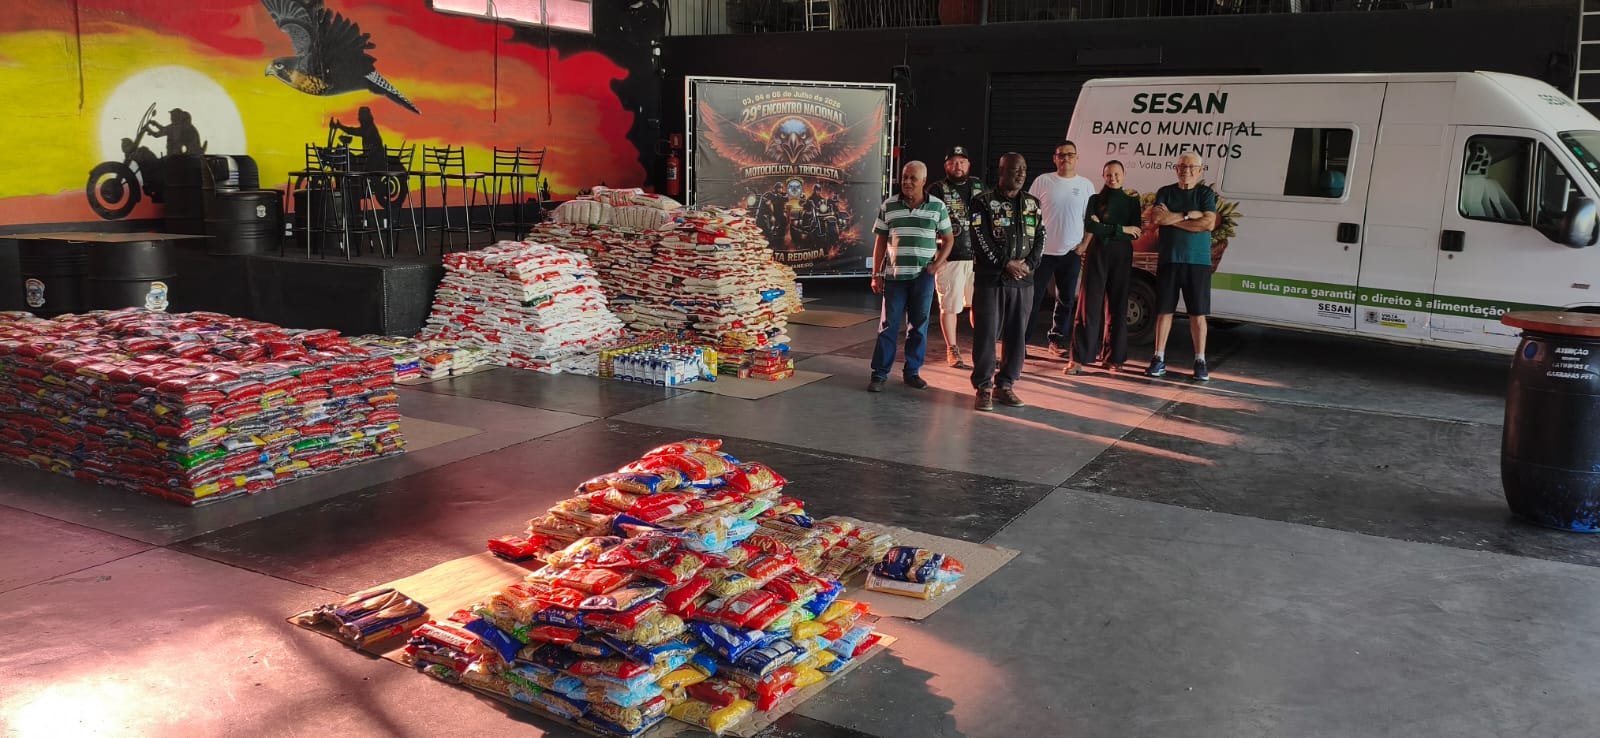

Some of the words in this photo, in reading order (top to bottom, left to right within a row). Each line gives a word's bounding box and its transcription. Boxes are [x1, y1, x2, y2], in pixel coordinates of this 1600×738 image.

[793, 91, 813, 99] Julho
[814, 94, 823, 102] de
[1131, 92, 1228, 114] SESAN
[761, 102, 801, 117] ENCONTRO
[803, 103, 843, 123] NACIONAL
[1092, 121, 1151, 135] BANCO
[1157, 121, 1263, 136] MUNICIPAL
[1106, 142, 1128, 156] DE
[1135, 142, 1242, 159] ALIMENTOS
[744, 165, 794, 177] MOTOCICLISTA
[799, 165, 839, 179] TRICICLISTA
[1140, 161, 1162, 170] Volta
[787, 248, 825, 262] REDONDA
[1241, 280, 1256, 289] Na
[1259, 281, 1280, 292] luta
[1283, 285, 1308, 295] para
[1310, 288, 1357, 300] garantir
[1360, 293, 1368, 301] o
[1371, 294, 1411, 306] direito
[1415, 298, 1423, 308] à
[1318, 303, 1352, 314] SESAN
